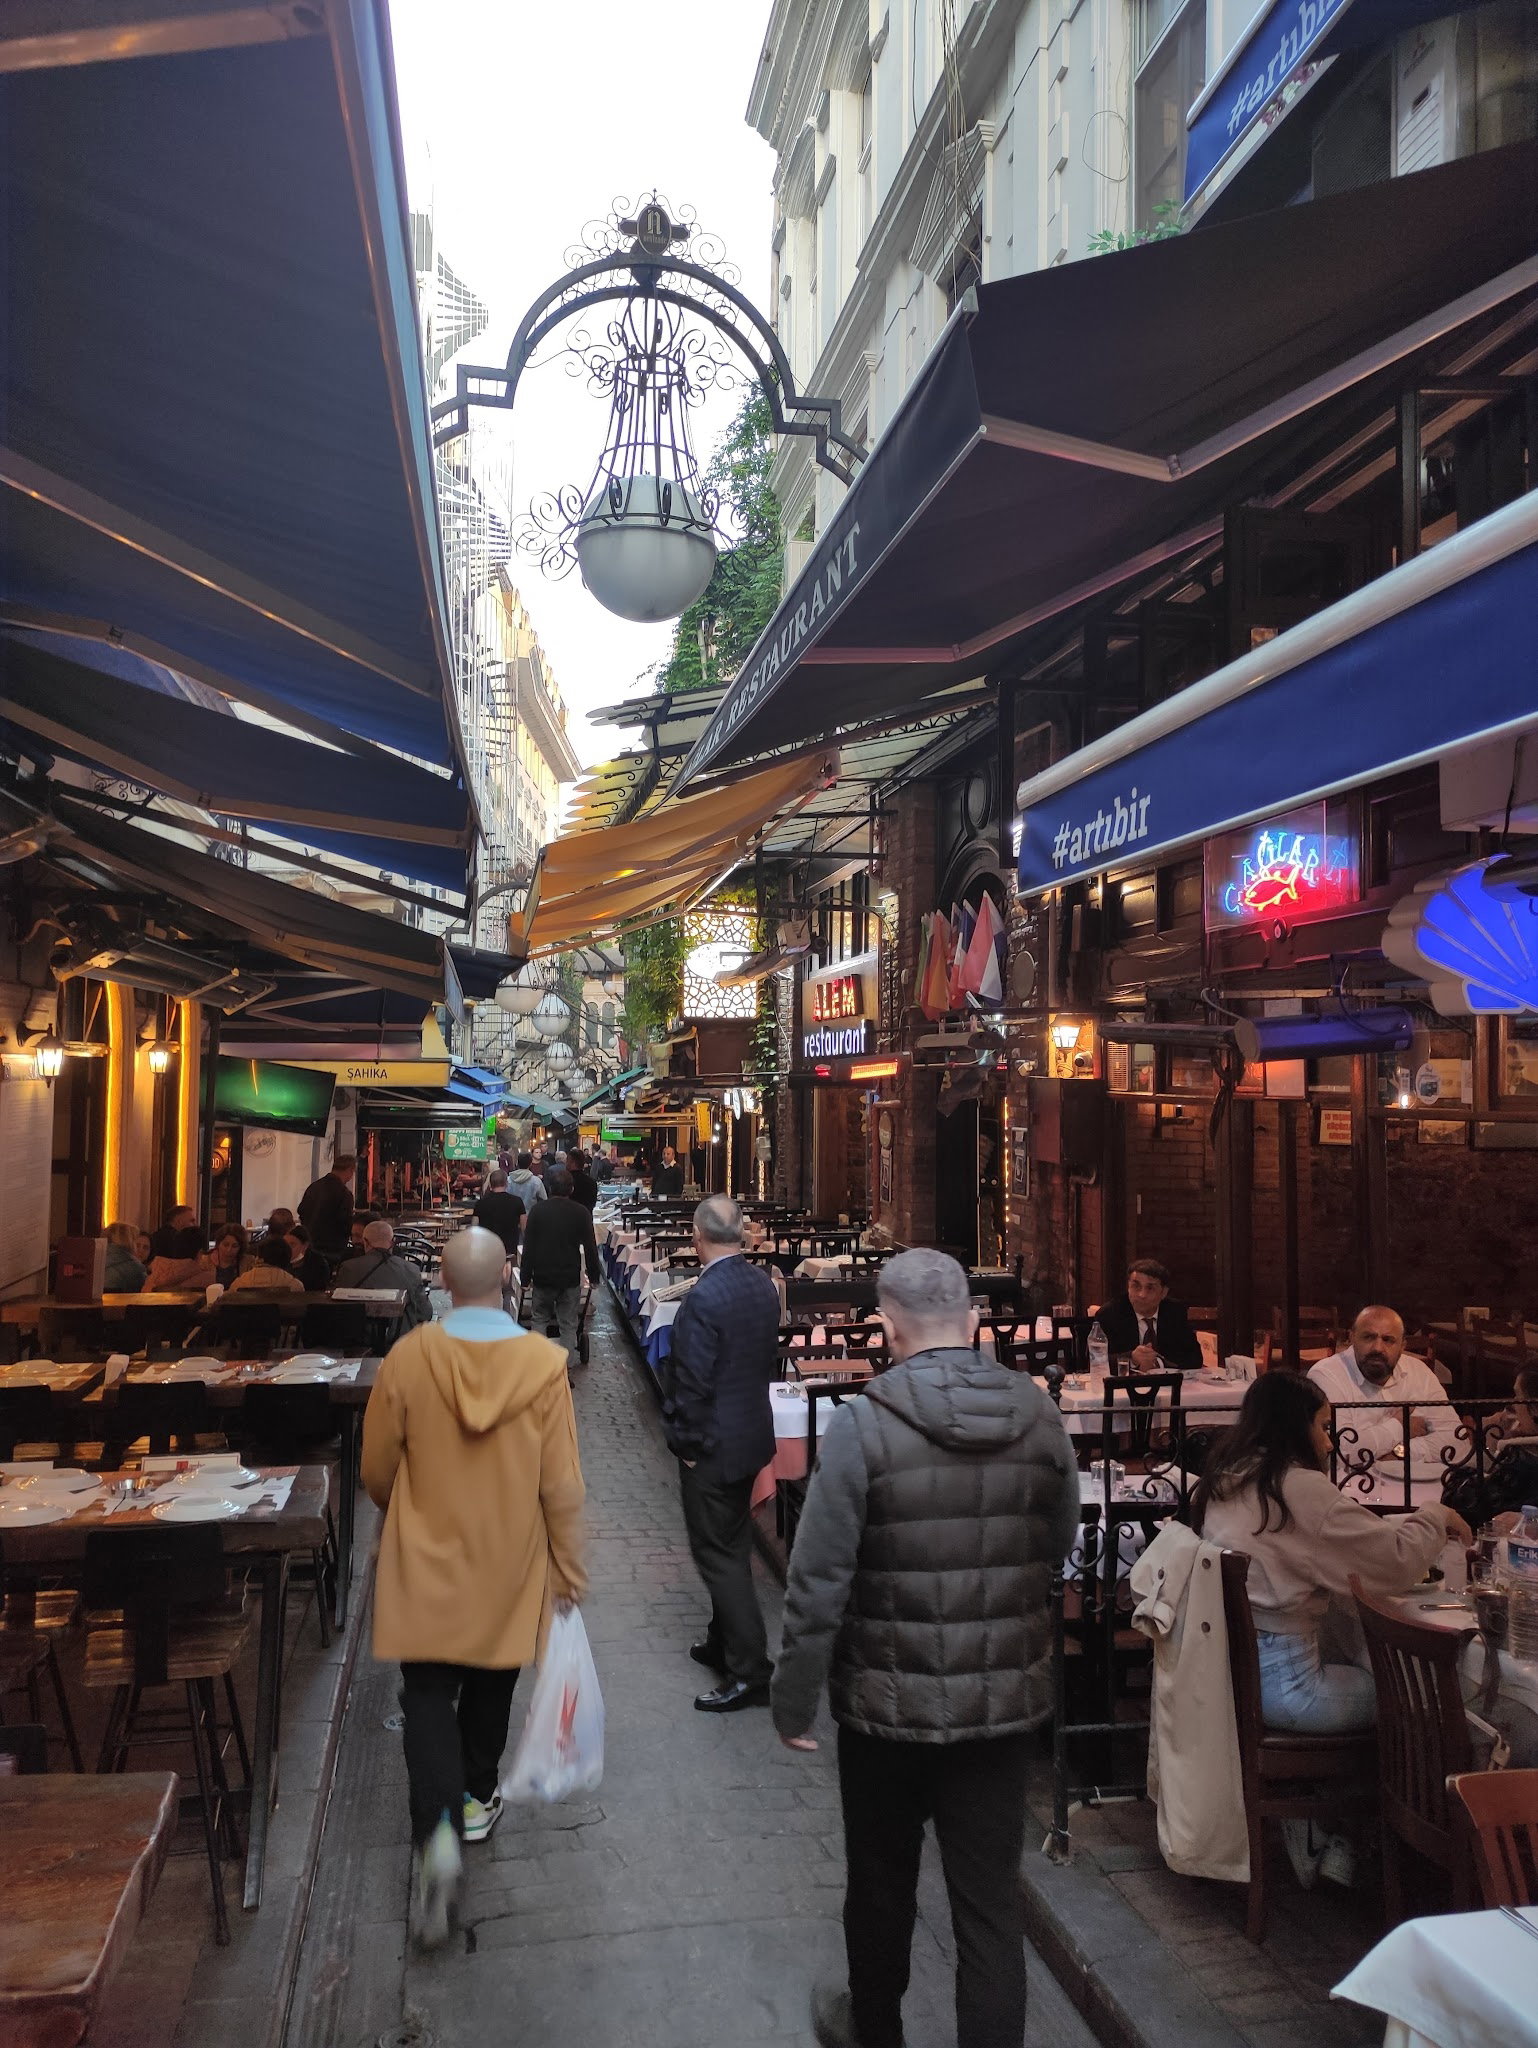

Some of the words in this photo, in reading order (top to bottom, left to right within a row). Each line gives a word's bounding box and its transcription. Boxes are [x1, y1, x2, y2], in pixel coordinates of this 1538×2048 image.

[1227, 0, 1335, 137] #artıbi
[725, 521, 861, 733] RESTAURANT
[1052, 787, 1151, 870] #artıbir
[812, 974, 857, 1022] ALEM
[804, 1018, 867, 1058] restaurant
[347, 1066, 388, 1081] ŞAHİKA
